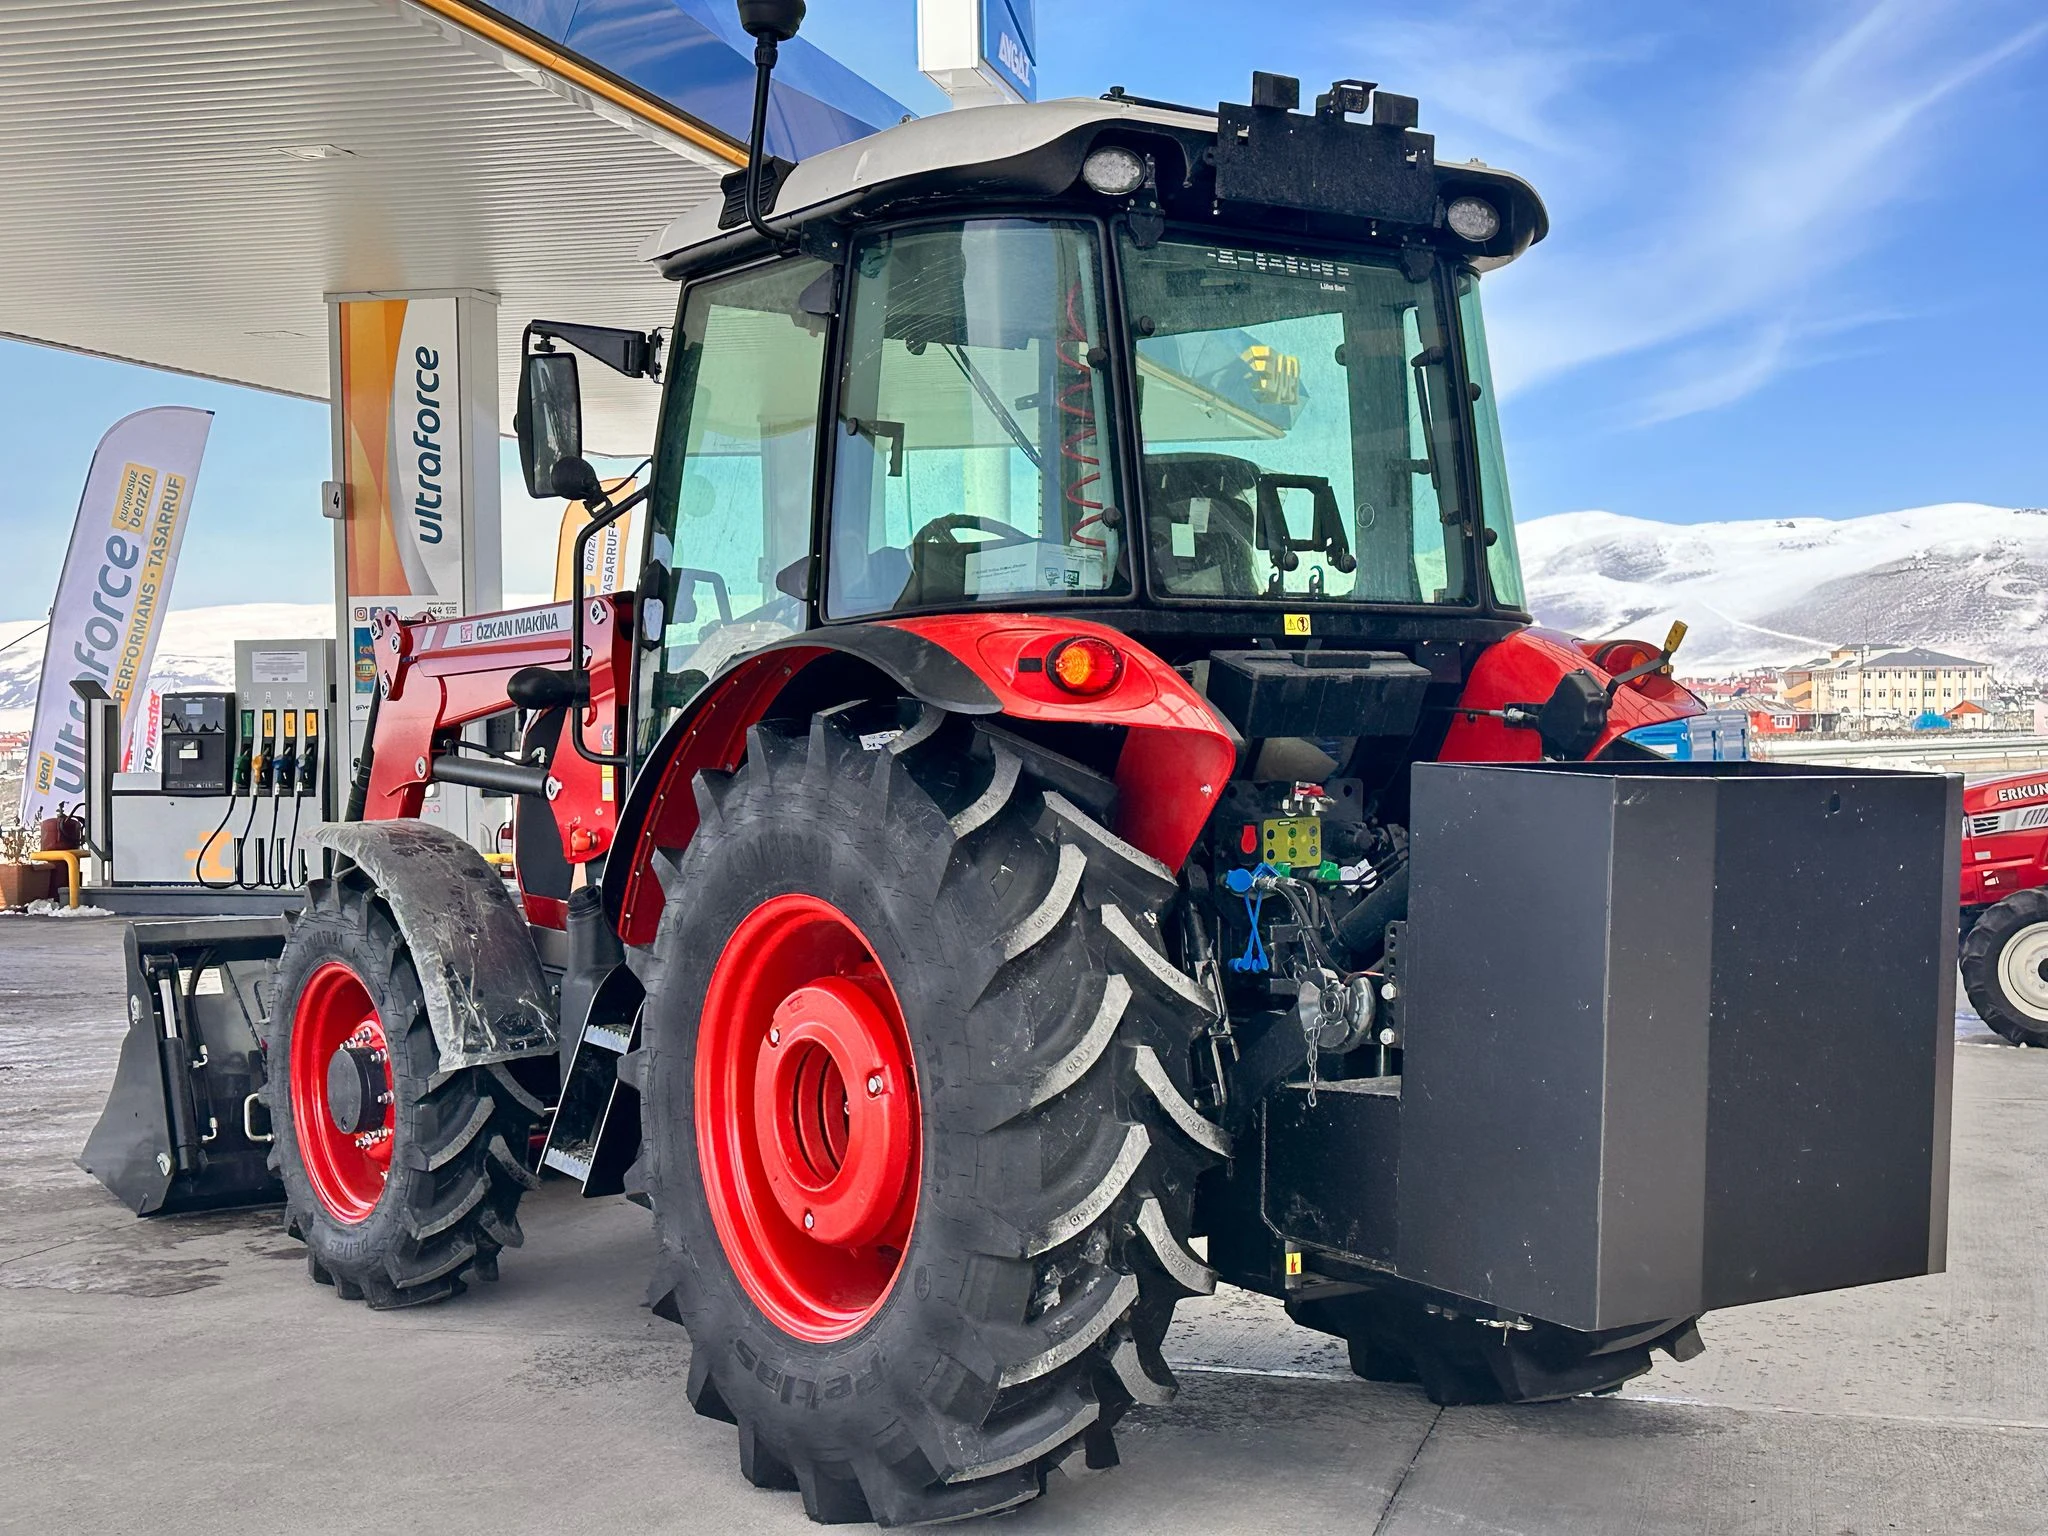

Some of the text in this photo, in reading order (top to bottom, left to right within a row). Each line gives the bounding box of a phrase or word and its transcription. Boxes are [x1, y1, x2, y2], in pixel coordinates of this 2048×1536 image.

[998, 31, 1031, 88] AYGAZ
[413, 345, 443, 545] ultraforce
[119, 469, 138, 522] kurşunsuz
[128, 473, 152, 528] benzin
[332, 491, 340, 509] 4
[113, 477, 181, 702] PERFORMANS TASARRUF
[476, 611, 559, 640] ÖZKAN MAKİNA
[37, 756, 52, 791] yeni
